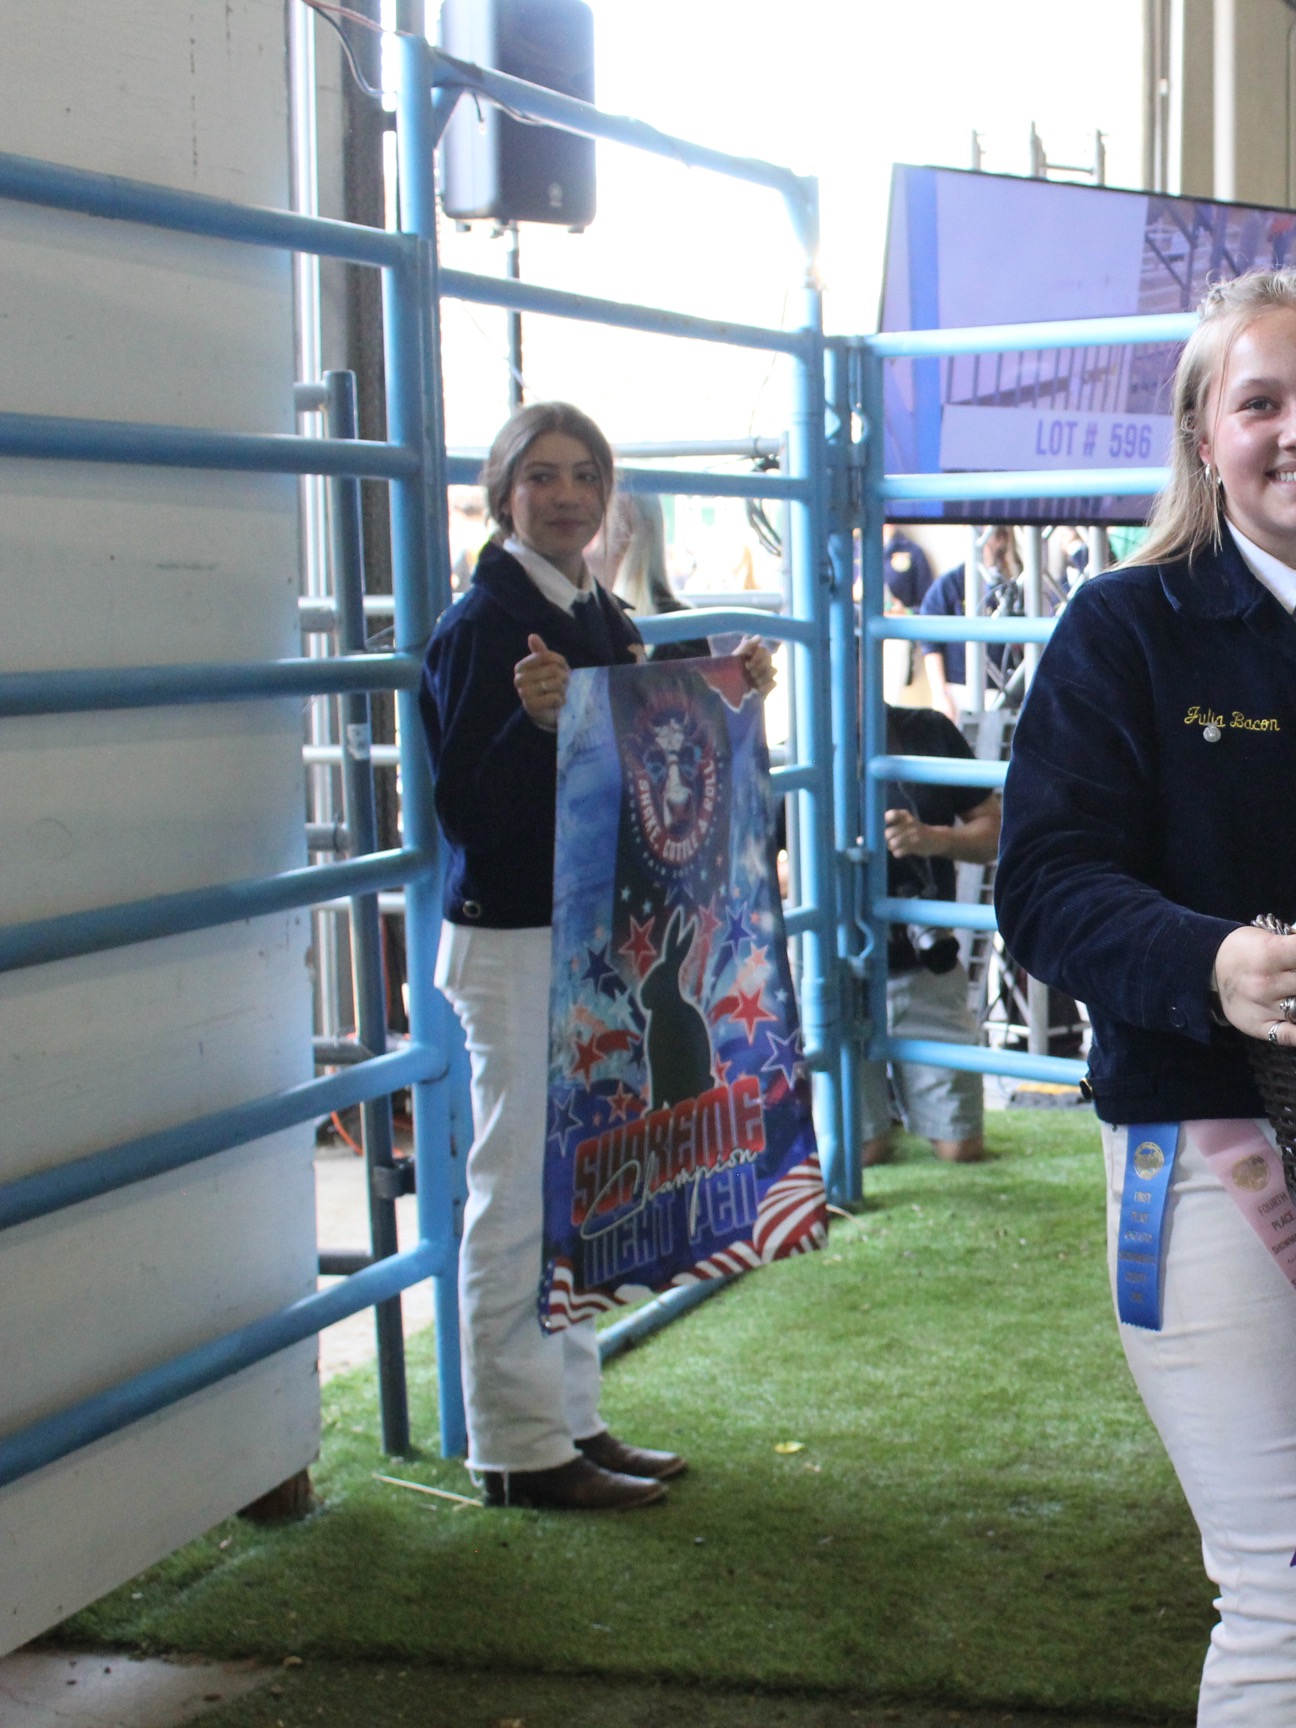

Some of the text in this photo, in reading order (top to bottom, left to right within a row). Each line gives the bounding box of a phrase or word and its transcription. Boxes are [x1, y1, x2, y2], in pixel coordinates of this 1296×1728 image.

[1036, 418, 1152, 459] LOT # 596
[1183, 705, 1281, 731] Julia Bacon
[1257, 1192, 1289, 1217] FOURTH
[1271, 1210, 1296, 1232] PLACE
